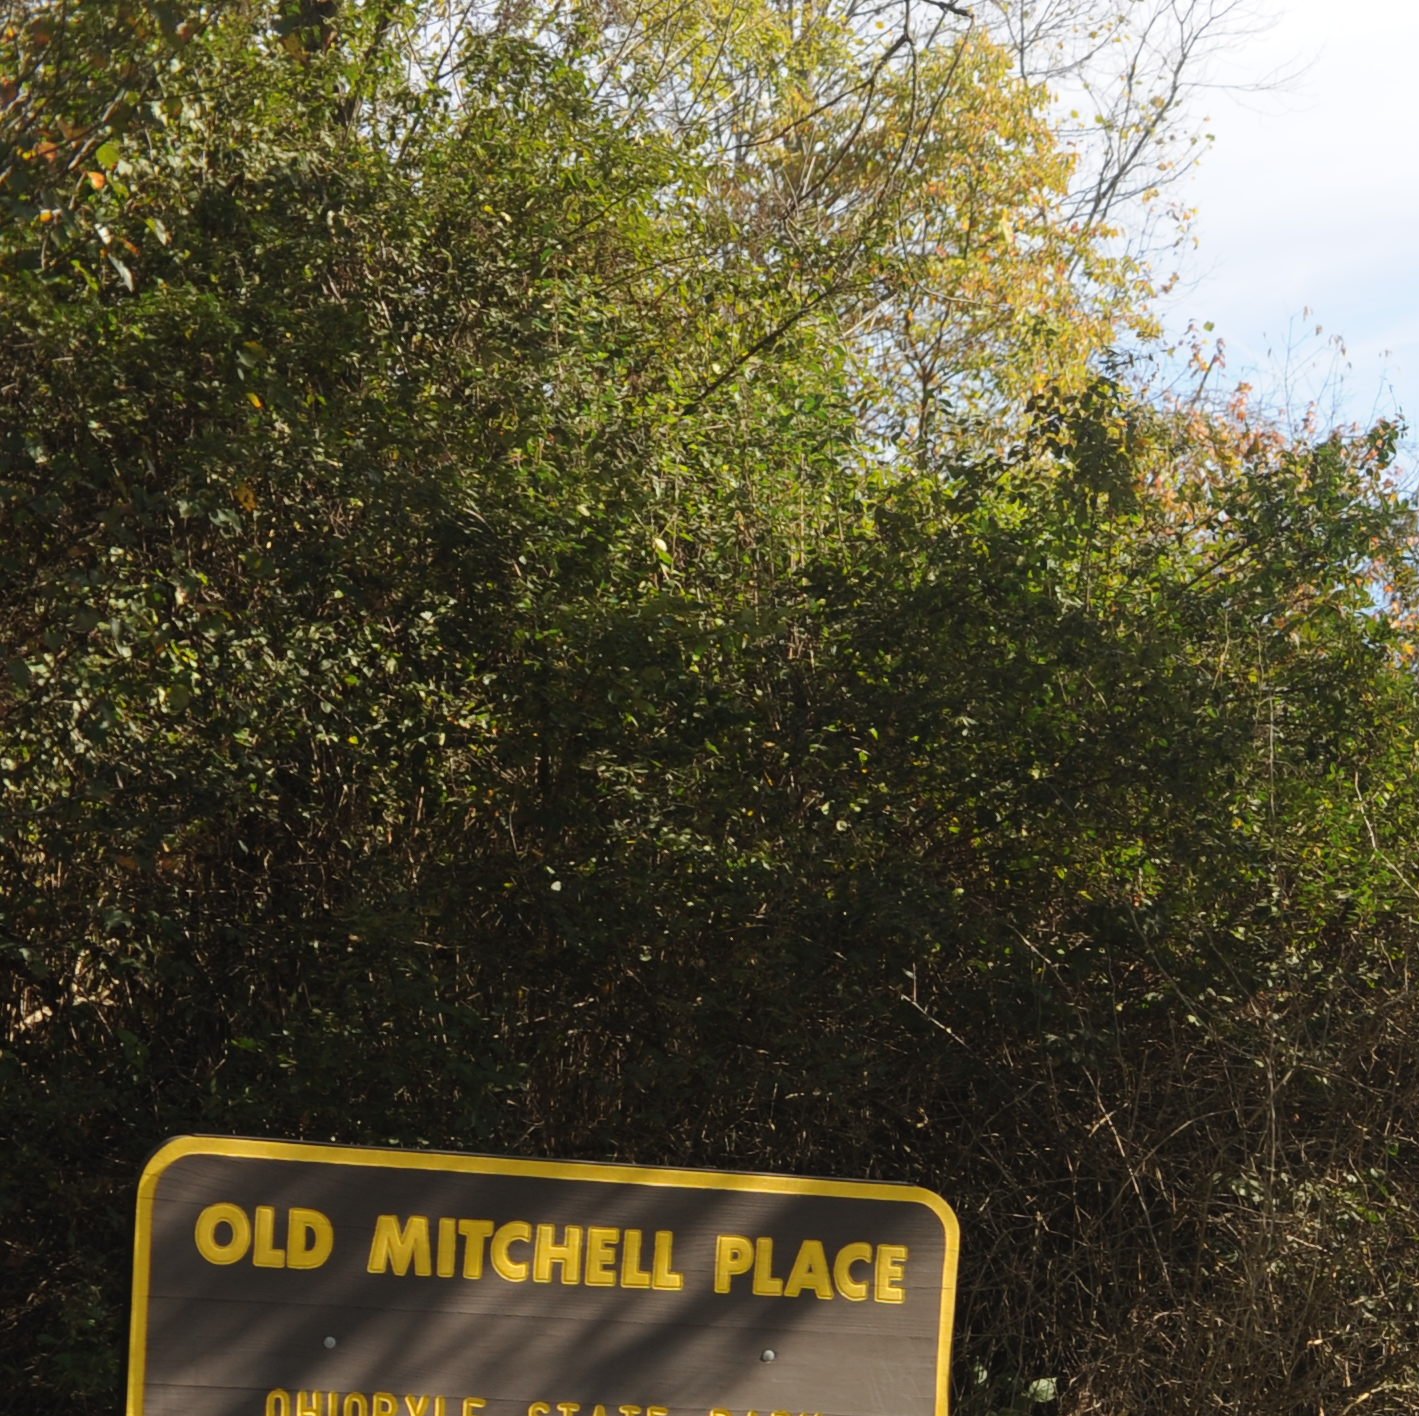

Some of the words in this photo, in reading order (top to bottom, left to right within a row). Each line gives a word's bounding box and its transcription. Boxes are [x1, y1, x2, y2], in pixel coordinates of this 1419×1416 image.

[194, 1202, 334, 1270] OLD
[367, 1214, 685, 1292] MITCHELL
[714, 1233, 908, 1305] PLACE
